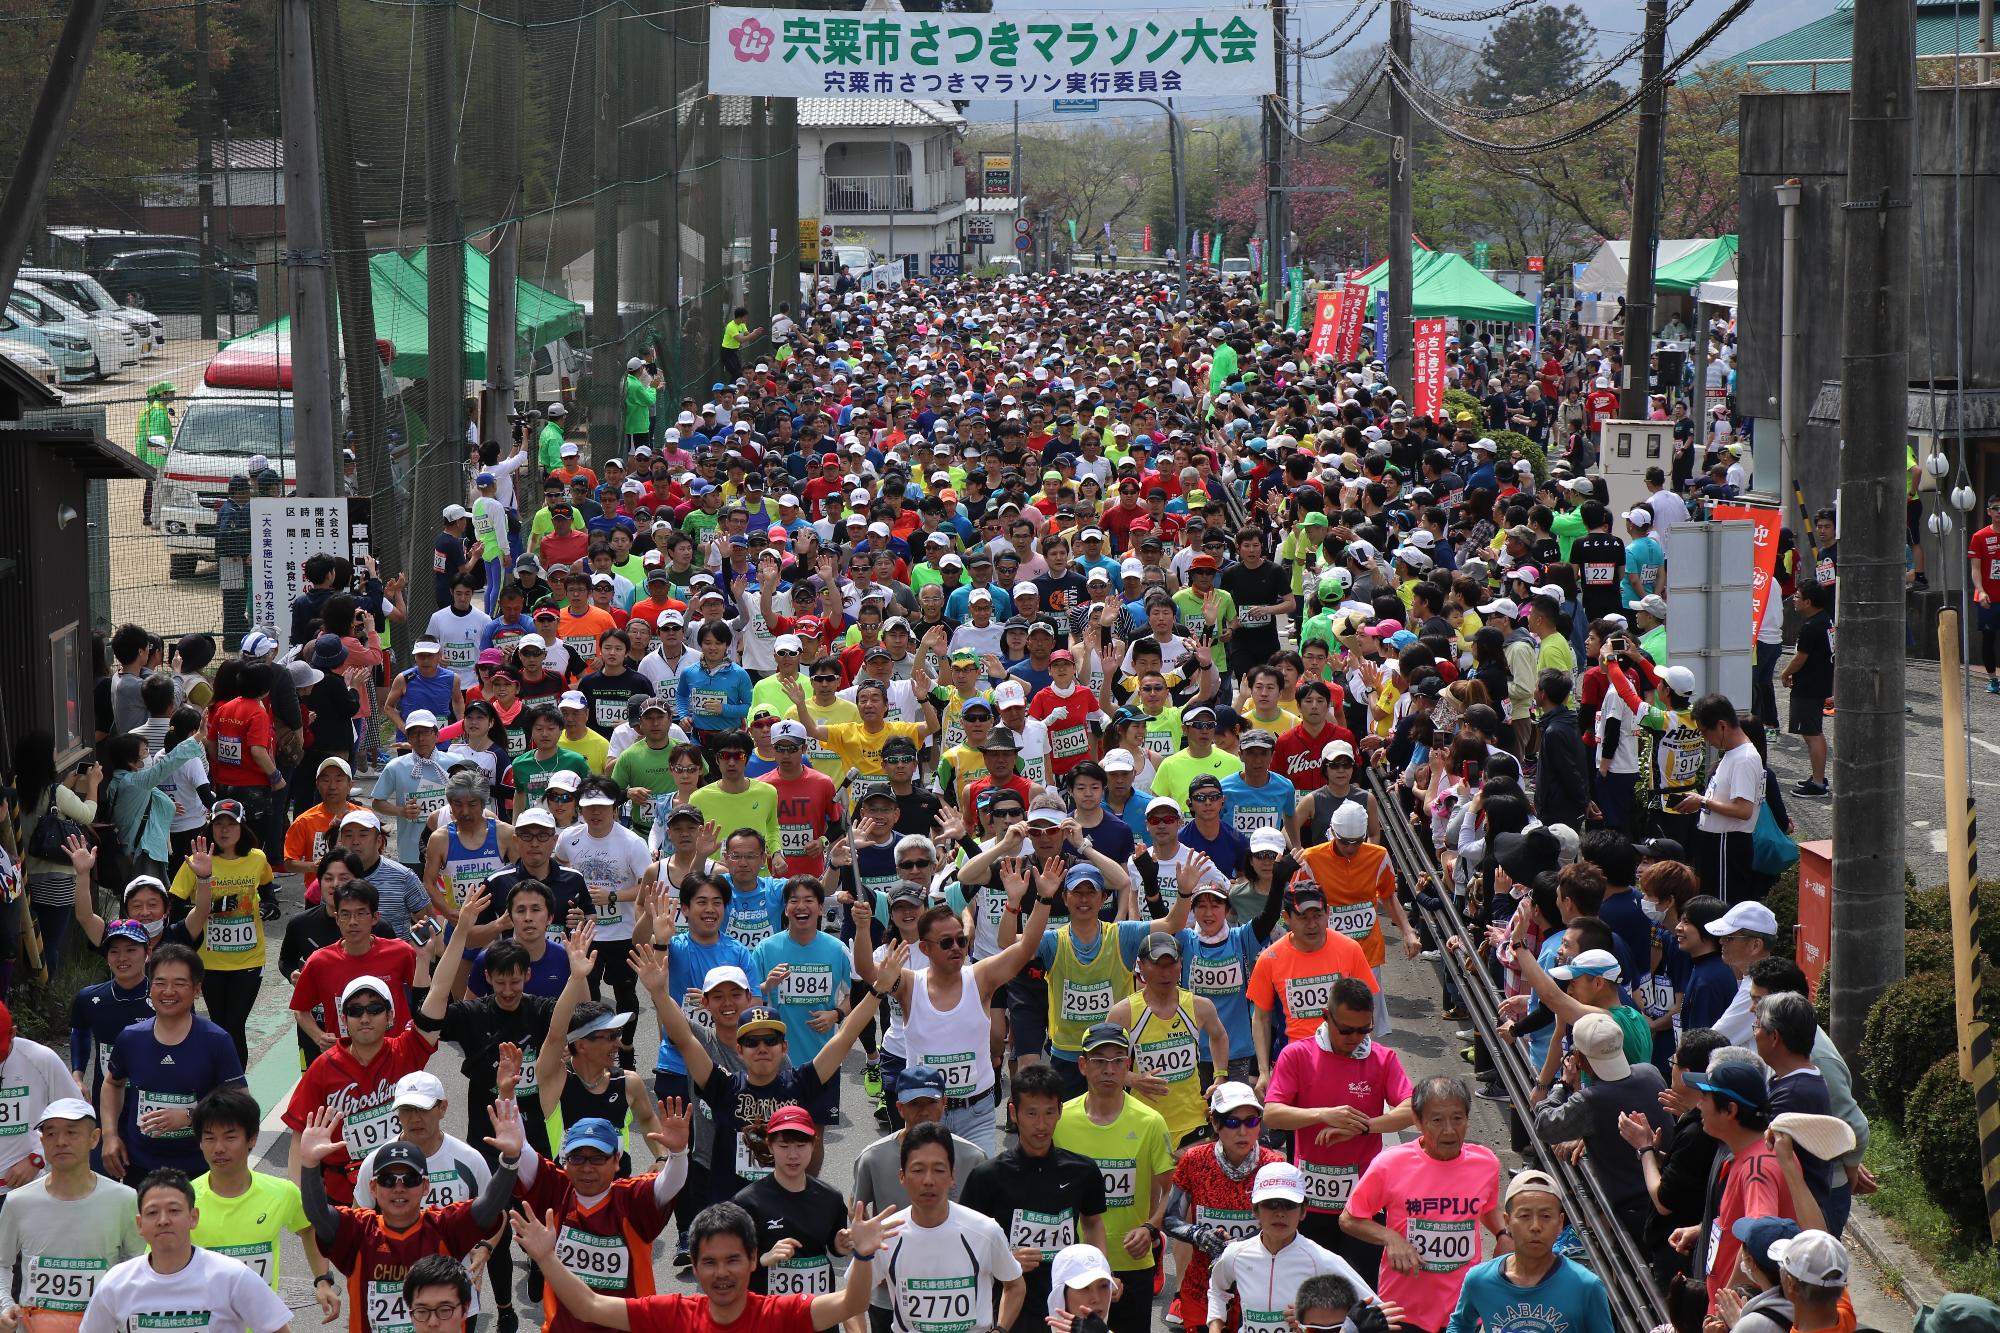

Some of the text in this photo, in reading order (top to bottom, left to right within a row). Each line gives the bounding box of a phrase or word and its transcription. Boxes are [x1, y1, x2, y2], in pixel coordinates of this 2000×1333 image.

[782, 14, 1259, 67] 宍粟市さつきマラソン大会
[824, 70, 1183, 94] 宍粟市さつきマラソン実行委員会
[944, 256, 959, 268] IN
[1592, 567, 1608, 580] 22
[599, 708, 629, 720] 1946
[1054, 732, 1086, 750] 3804
[220, 743, 239, 758] 562
[1680, 755, 1701, 773] 914
[1237, 814, 1275, 830] 3201
[456, 862, 493, 873] 神戸PIJC
[216, 876, 255, 888] MARUGAME
[1333, 911, 1374, 931] 2902
[211, 926, 253, 942] 3810
[785, 976, 829, 994] 1984
[1195, 967, 1238, 987] 3907
[1066, 992, 1110, 1011] 2953
[752, 1008, 769, 1022] Bs
[1144, 1036, 1191, 1052] ハチ食品株式会社
[1142, 1048, 1193, 1073] 3402
[148, 1091, 196, 1103] 西兵庫信用金庫
[351, 1115, 403, 1148] 1973
[1304, 1174, 1354, 1198] 2697
[1405, 1198, 1481, 1216] 神戸PIJC
[1419, 1221, 1473, 1231] ハチ食品株式会社
[570, 1230, 623, 1247] 西兵庫信用金庫
[1017, 1225, 1071, 1248] 2416
[1414, 1233, 1471, 1258] 3400
[43, 1258, 102, 1269] 西兵庫信用金庫
[561, 1243, 622, 1274] 2989
[35, 1273, 95, 1298] 2951
[775, 1270, 828, 1294] 3615
[911, 1279, 970, 1289] 西兵庫信用金庫
[908, 1293, 970, 1318] 2770
[140, 1316, 204, 1328] ハチ食品株式会社
